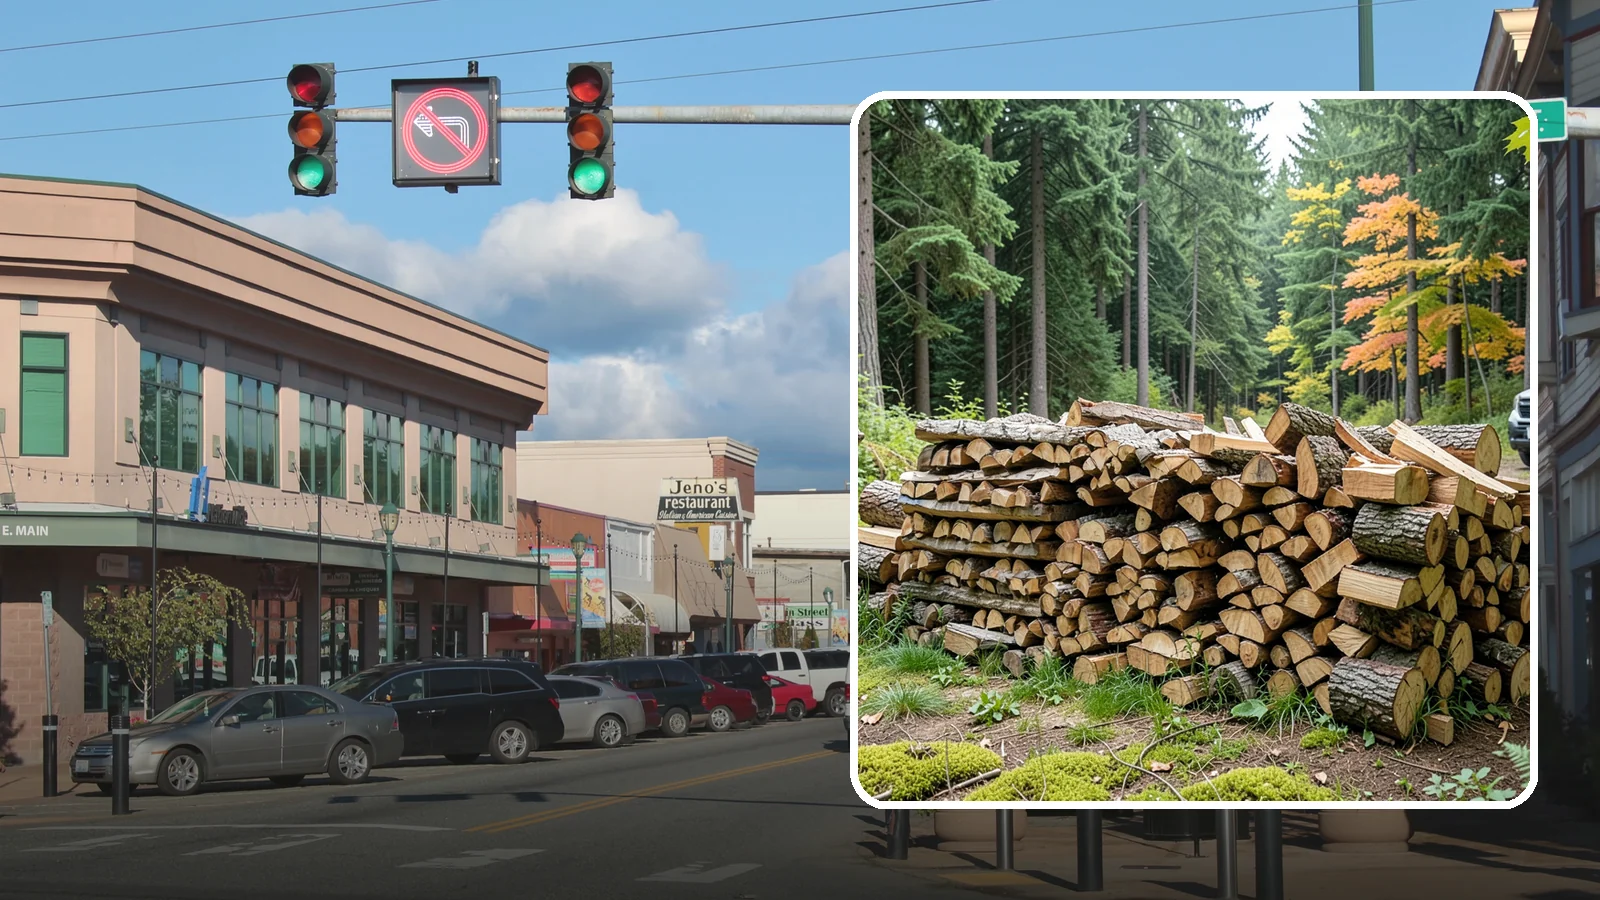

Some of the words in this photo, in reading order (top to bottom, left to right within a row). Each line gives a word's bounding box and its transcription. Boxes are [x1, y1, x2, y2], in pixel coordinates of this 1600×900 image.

[670, 480, 727, 494] Jeno's
[665, 496, 730, 508] restaurant
[658, 510, 681, 519] Italian
[686, 510, 714, 519] American
[715, 510, 737, 519] Cuisine
[2, 525, 13, 536] E.
[16, 525, 49, 536] MAIN
[797, 608, 828, 616] Street
